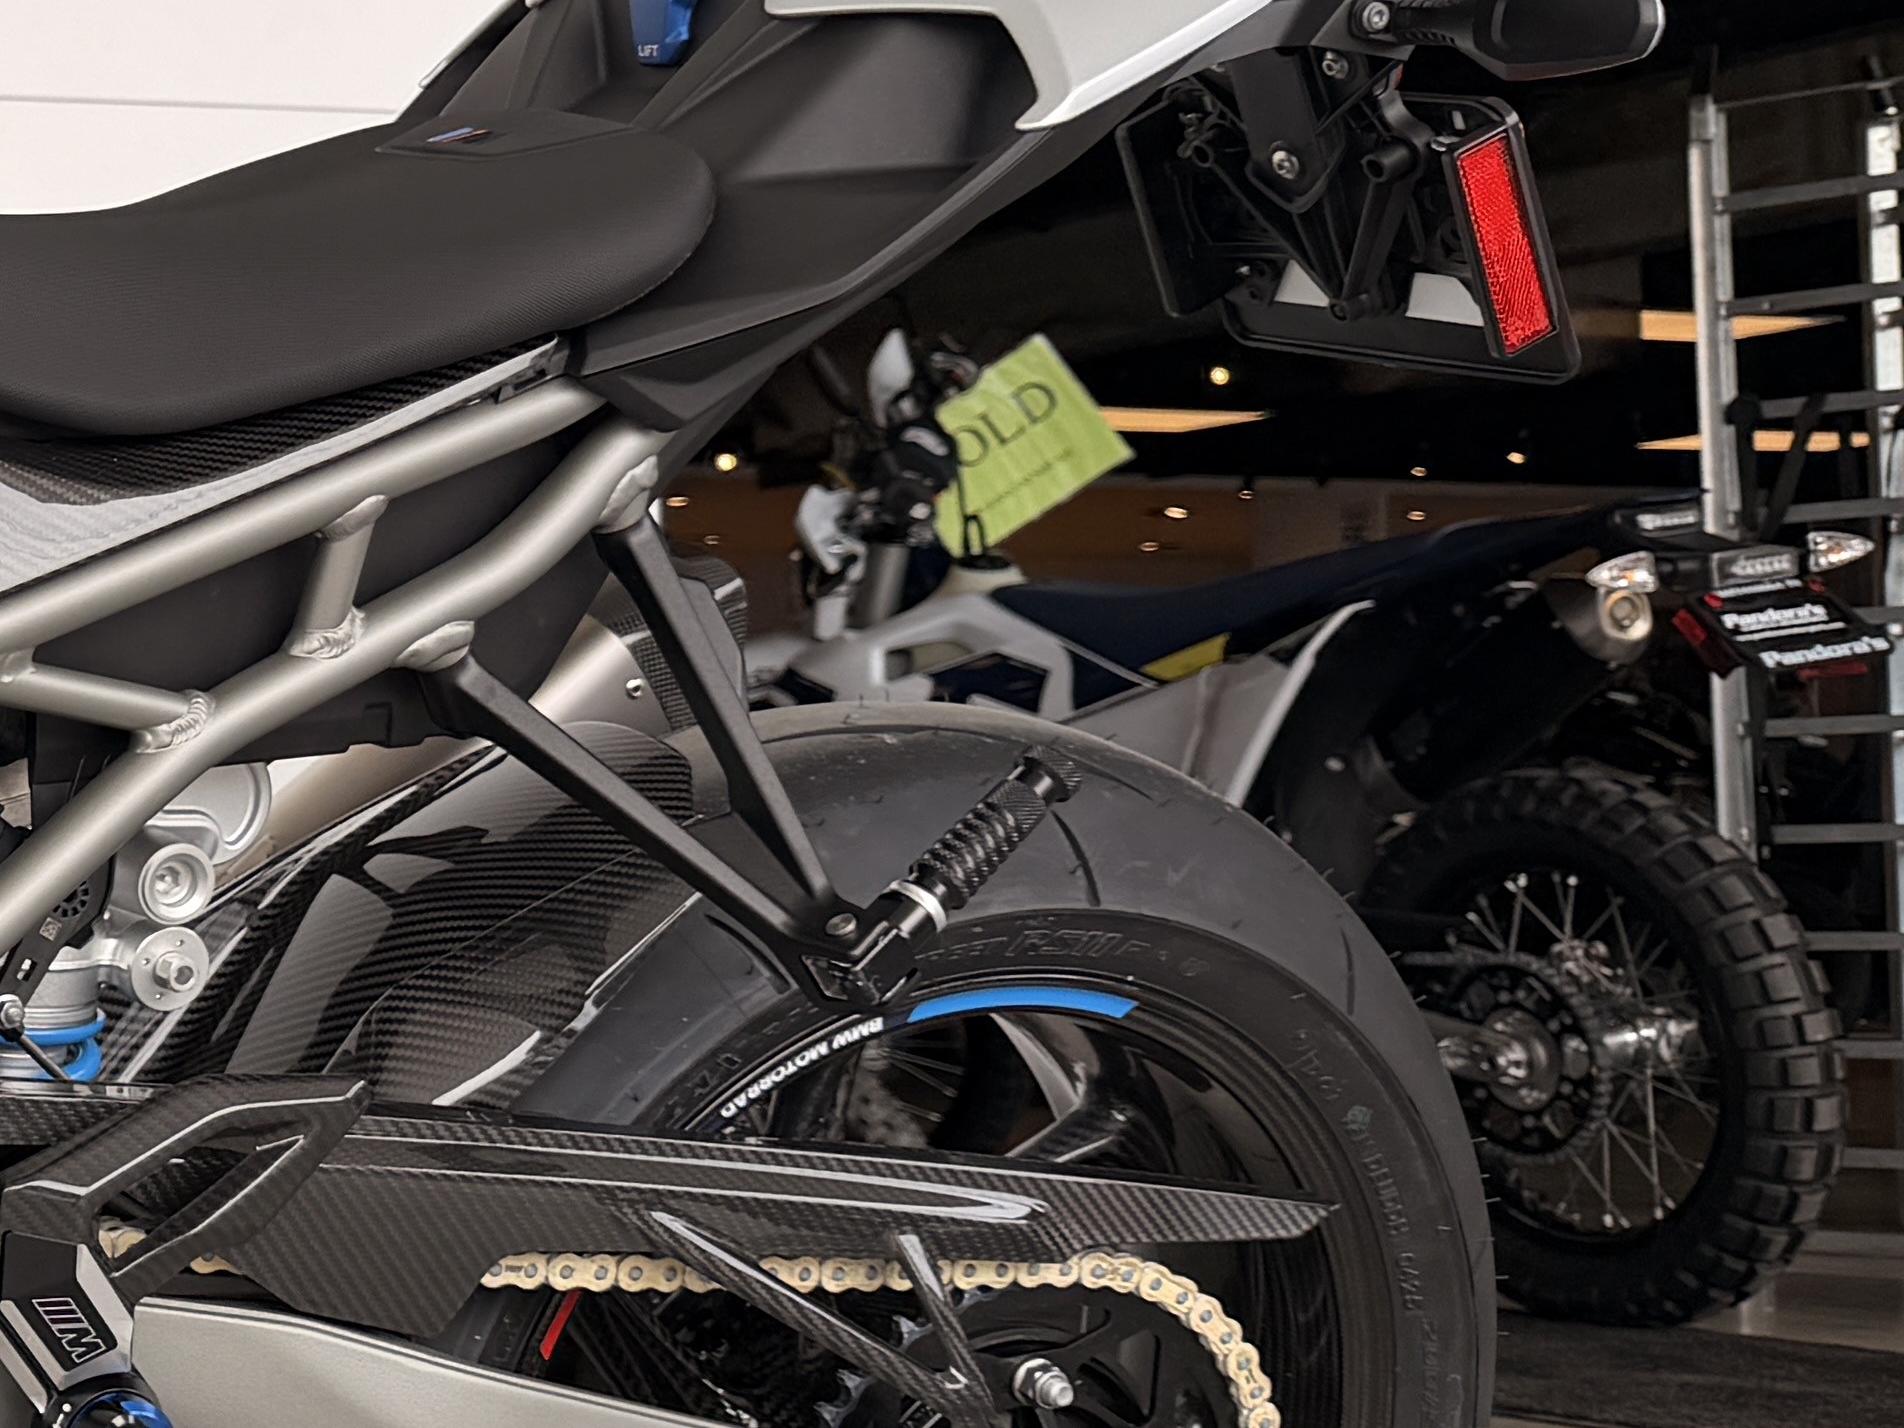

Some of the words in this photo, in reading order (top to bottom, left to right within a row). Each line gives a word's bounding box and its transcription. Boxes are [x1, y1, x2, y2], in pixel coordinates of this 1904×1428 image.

[637, 44, 659, 57] LIFT
[954, 381, 1057, 468] OLD
[1759, 636, 1891, 668] Pandora's
[832, 1016, 884, 1053] BMW
[720, 1041, 832, 1119] MOTORRAD
